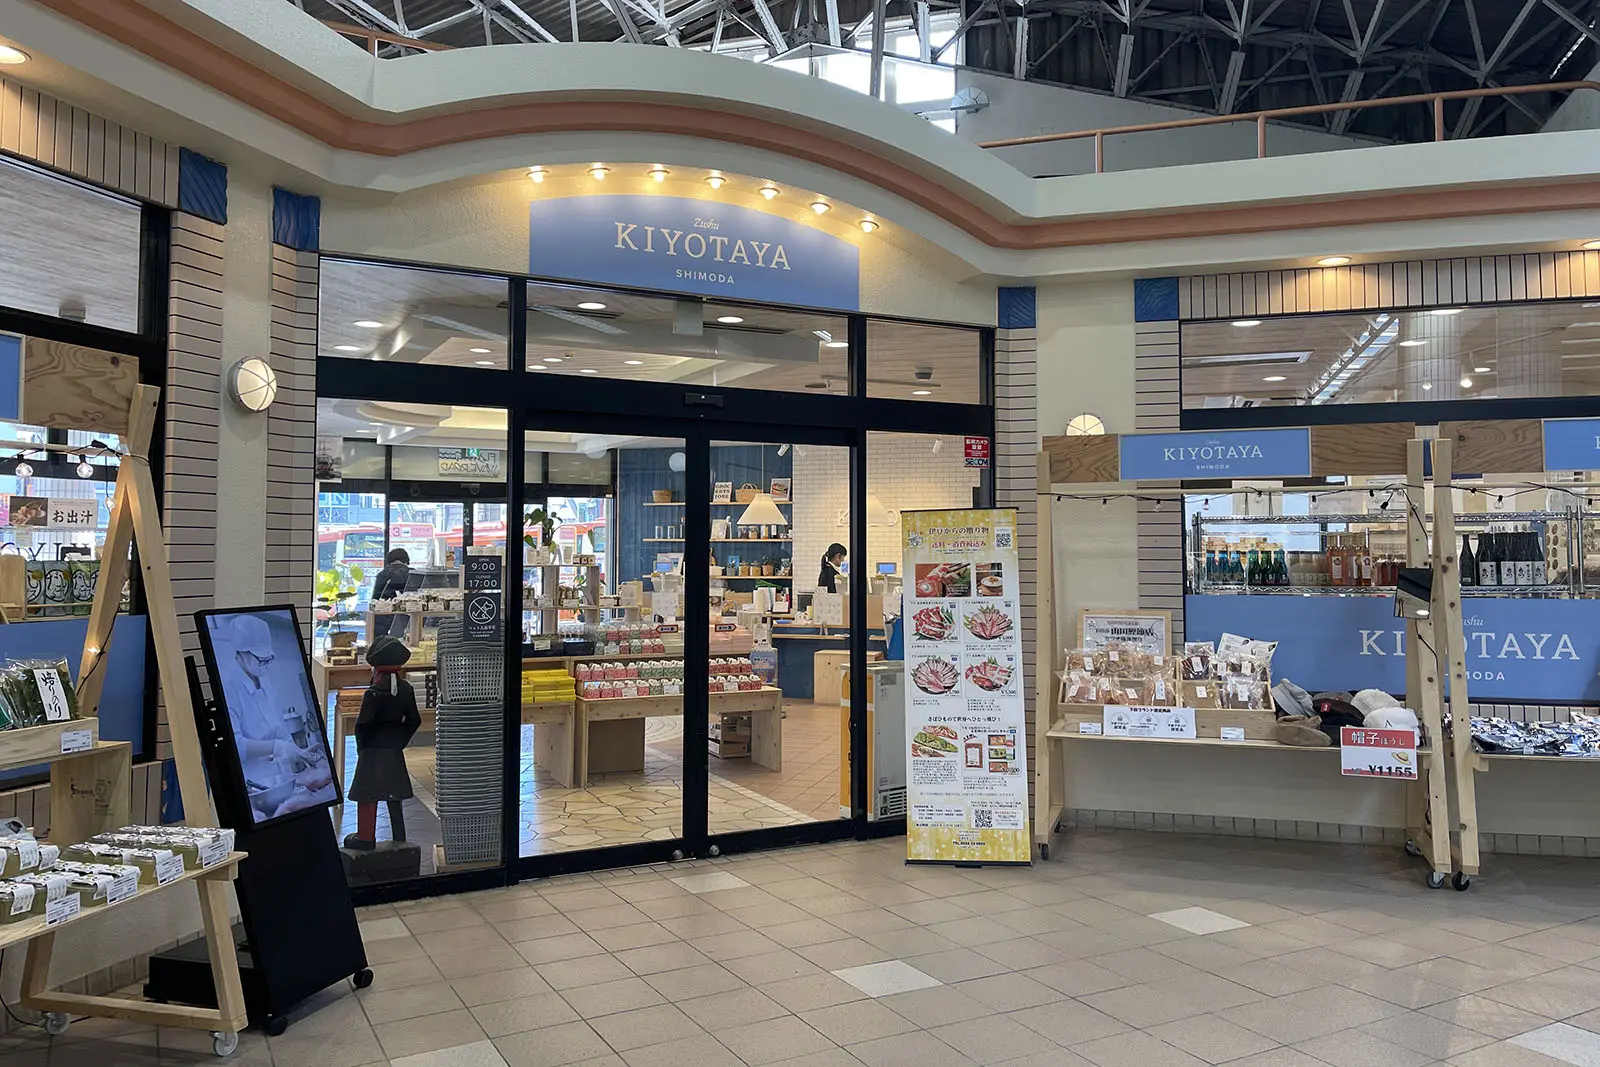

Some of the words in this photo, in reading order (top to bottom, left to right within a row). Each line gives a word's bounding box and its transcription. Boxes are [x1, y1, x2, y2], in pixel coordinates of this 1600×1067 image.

[693, 217, 720, 230] Zushu
[613, 222, 792, 271] KIYOTAYA
[676, 268, 735, 284] SHIMODA
[1163, 445, 1263, 461] KIYOTAYA
[965, 457, 989, 466] SECOM
[52, 509, 94, 524] お出汁
[471, 562, 496, 571] 9:00
[468, 579, 498, 588] 17:00
[1463, 615, 1484, 627] ushu
[1359, 629, 1580, 661] KITAYA
[1351, 731, 1380, 745] 帽子
[1368, 764, 1413, 777] ¥1155
